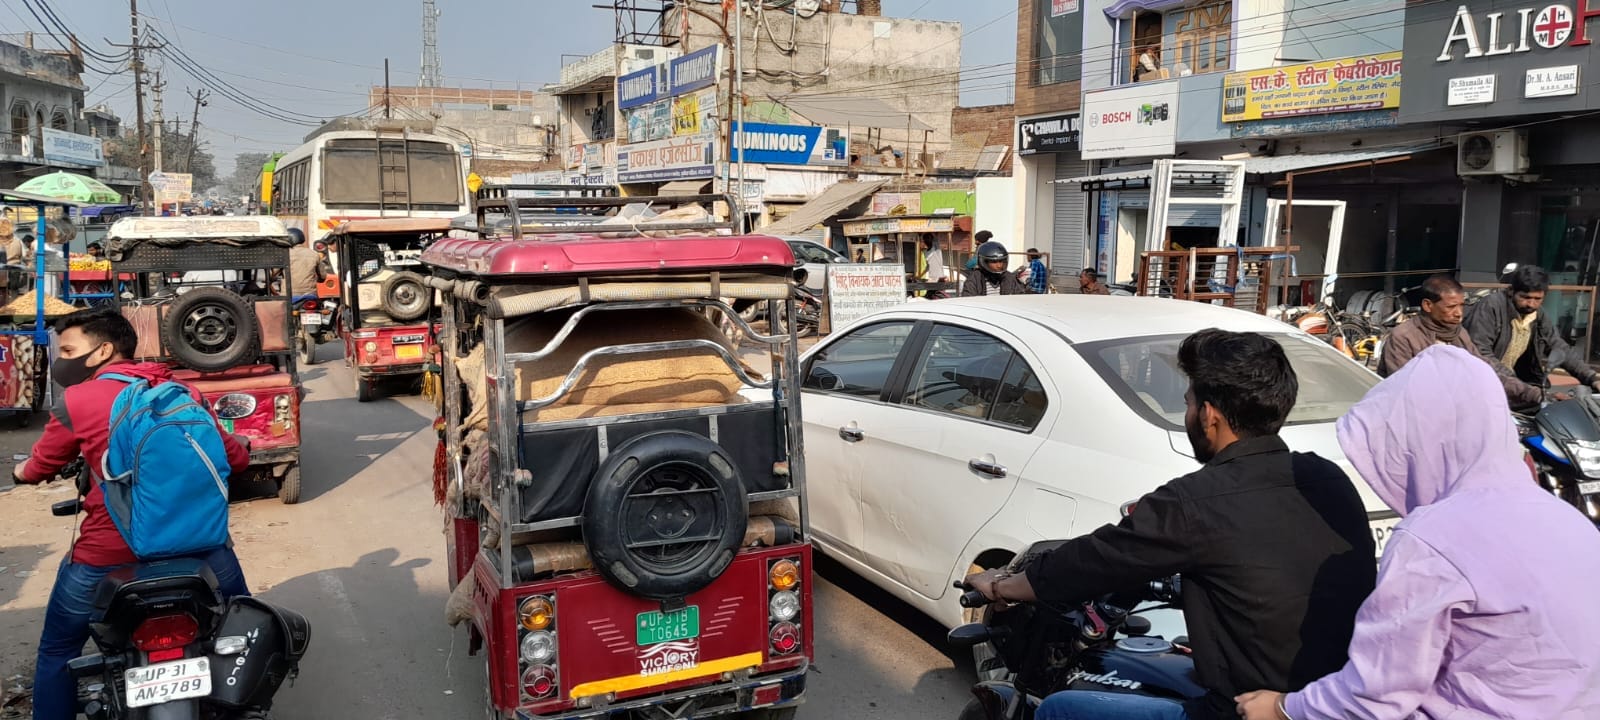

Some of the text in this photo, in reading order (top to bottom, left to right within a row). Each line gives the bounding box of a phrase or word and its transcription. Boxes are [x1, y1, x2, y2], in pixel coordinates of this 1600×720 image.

[1436, 5, 1535, 61] ALI
[674, 52, 713, 88] LUMINOUS
[1296, 66, 1328, 86] स्टील
[621, 72, 653, 102] LUMINOUS
[1034, 119, 1069, 136] CHAWLA
[1102, 111, 1132, 125] BOSCH
[640, 649, 698, 669] VICTORY
